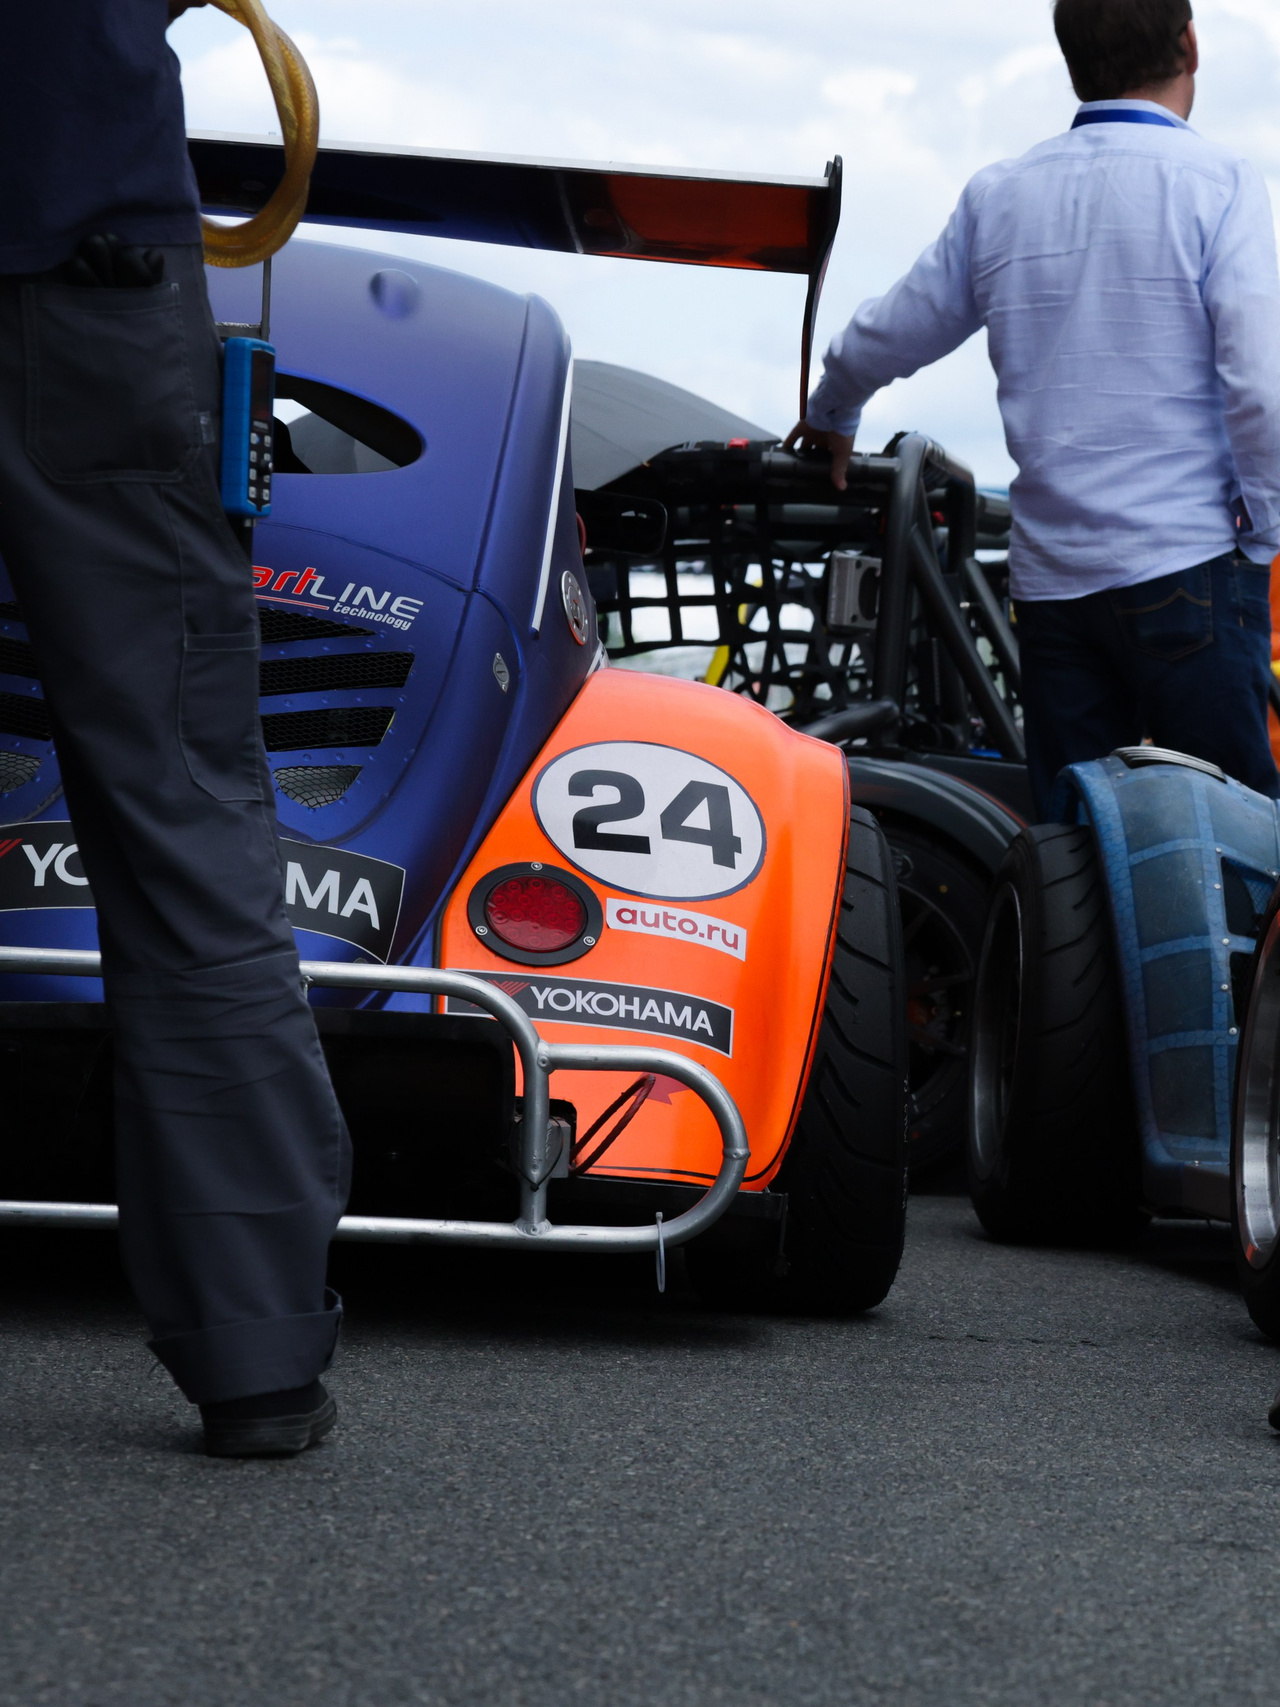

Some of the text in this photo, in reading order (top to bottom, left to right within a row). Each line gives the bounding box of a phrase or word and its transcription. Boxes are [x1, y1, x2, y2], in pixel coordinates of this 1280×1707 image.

[333, 602, 412, 631] technology
[567, 769, 742, 870] 24
[615, 907, 740, 950] auto.ru
[530, 986, 714, 1037] YOKOHAMA
